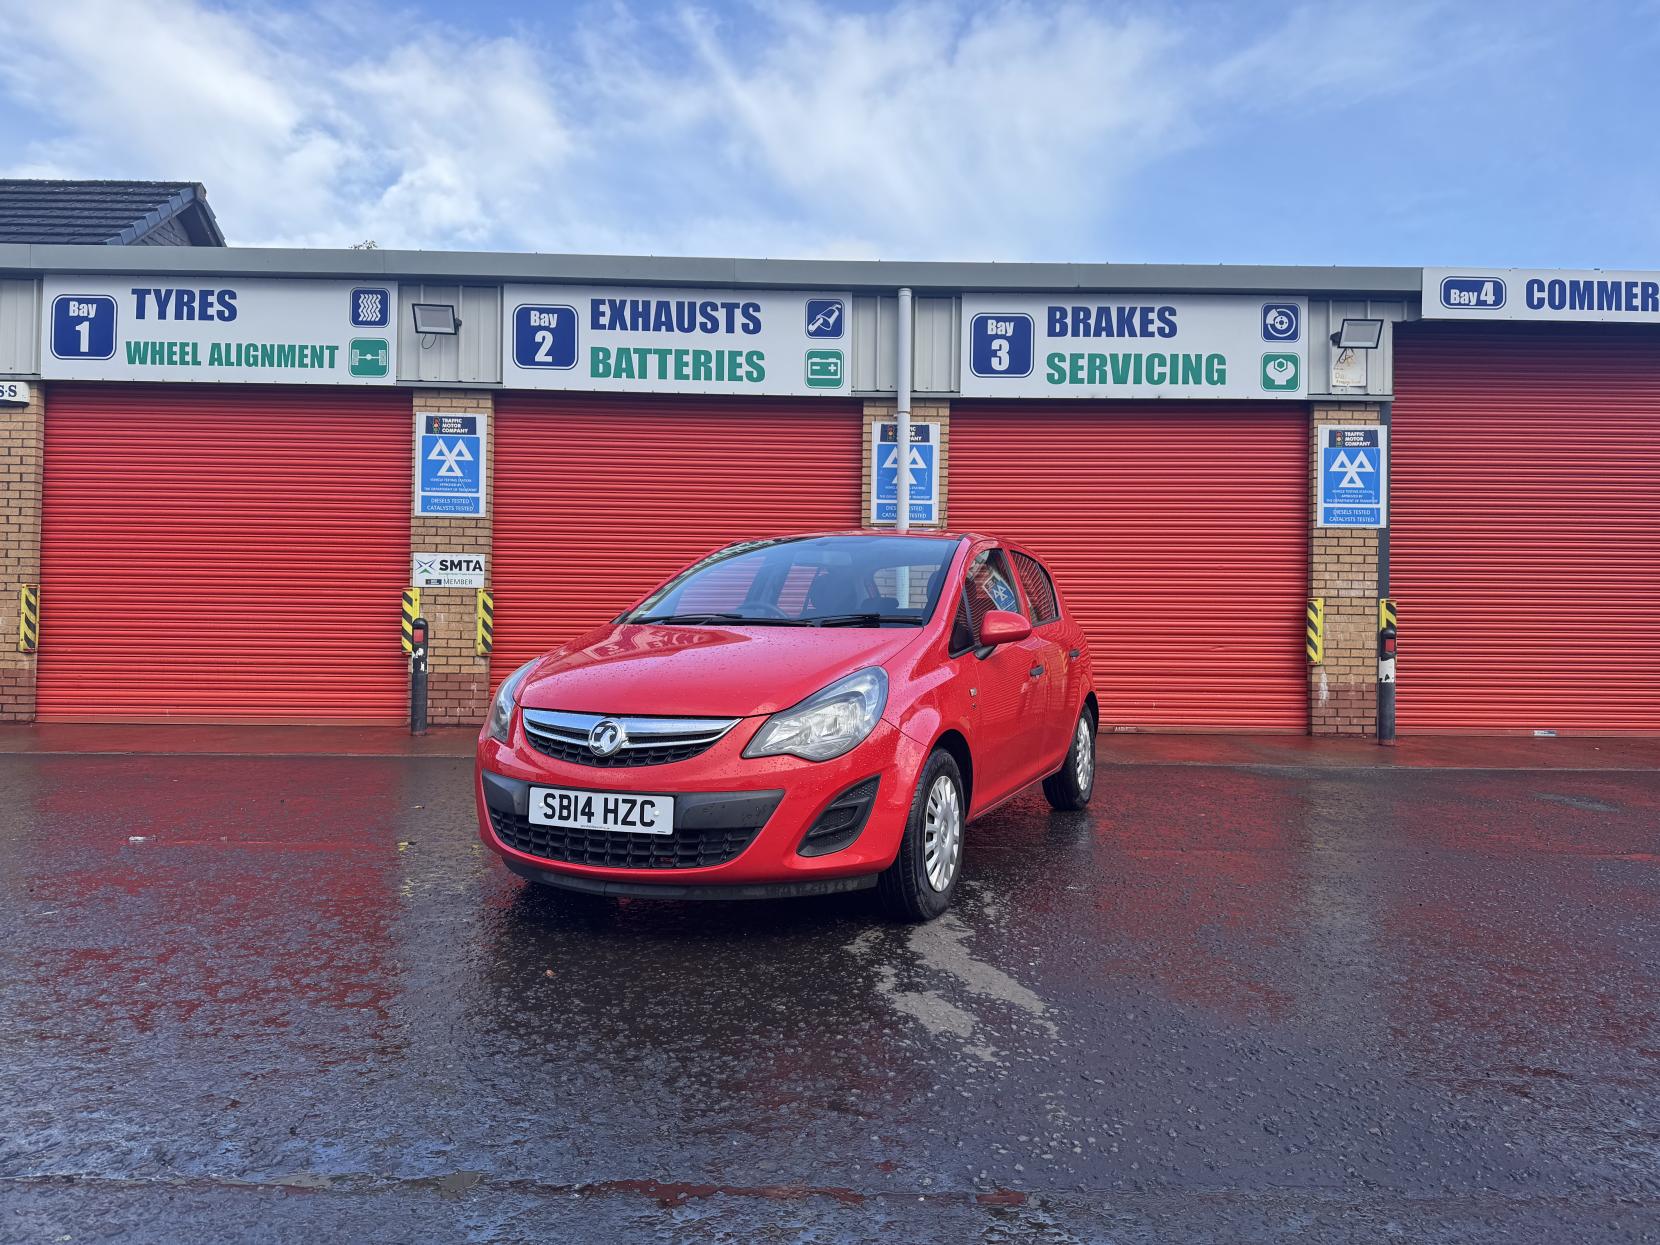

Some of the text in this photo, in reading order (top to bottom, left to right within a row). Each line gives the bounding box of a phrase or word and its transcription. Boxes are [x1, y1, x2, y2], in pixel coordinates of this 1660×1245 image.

[69, 301, 97, 318] Bay
[131, 287, 238, 322] TYRES
[1450, 281, 1496, 306] Bay 4
[1525, 278, 1660, 312] COMMER
[530, 310, 558, 328] Bay
[590, 298, 762, 335] EXHAUSTS
[987, 319, 1014, 336] Bay
[1047, 306, 1178, 338] BRAKES
[76, 321, 90, 353] 1
[534, 331, 554, 363] 2
[126, 340, 339, 369] WHEEL ALIGNMENT
[590, 346, 766, 383] BATTERIES
[991, 338, 1010, 371] 3
[1046, 352, 1227, 386] SERVICING
[439, 559, 483, 572] SMTA
[543, 792, 656, 828] SB14 HZC
